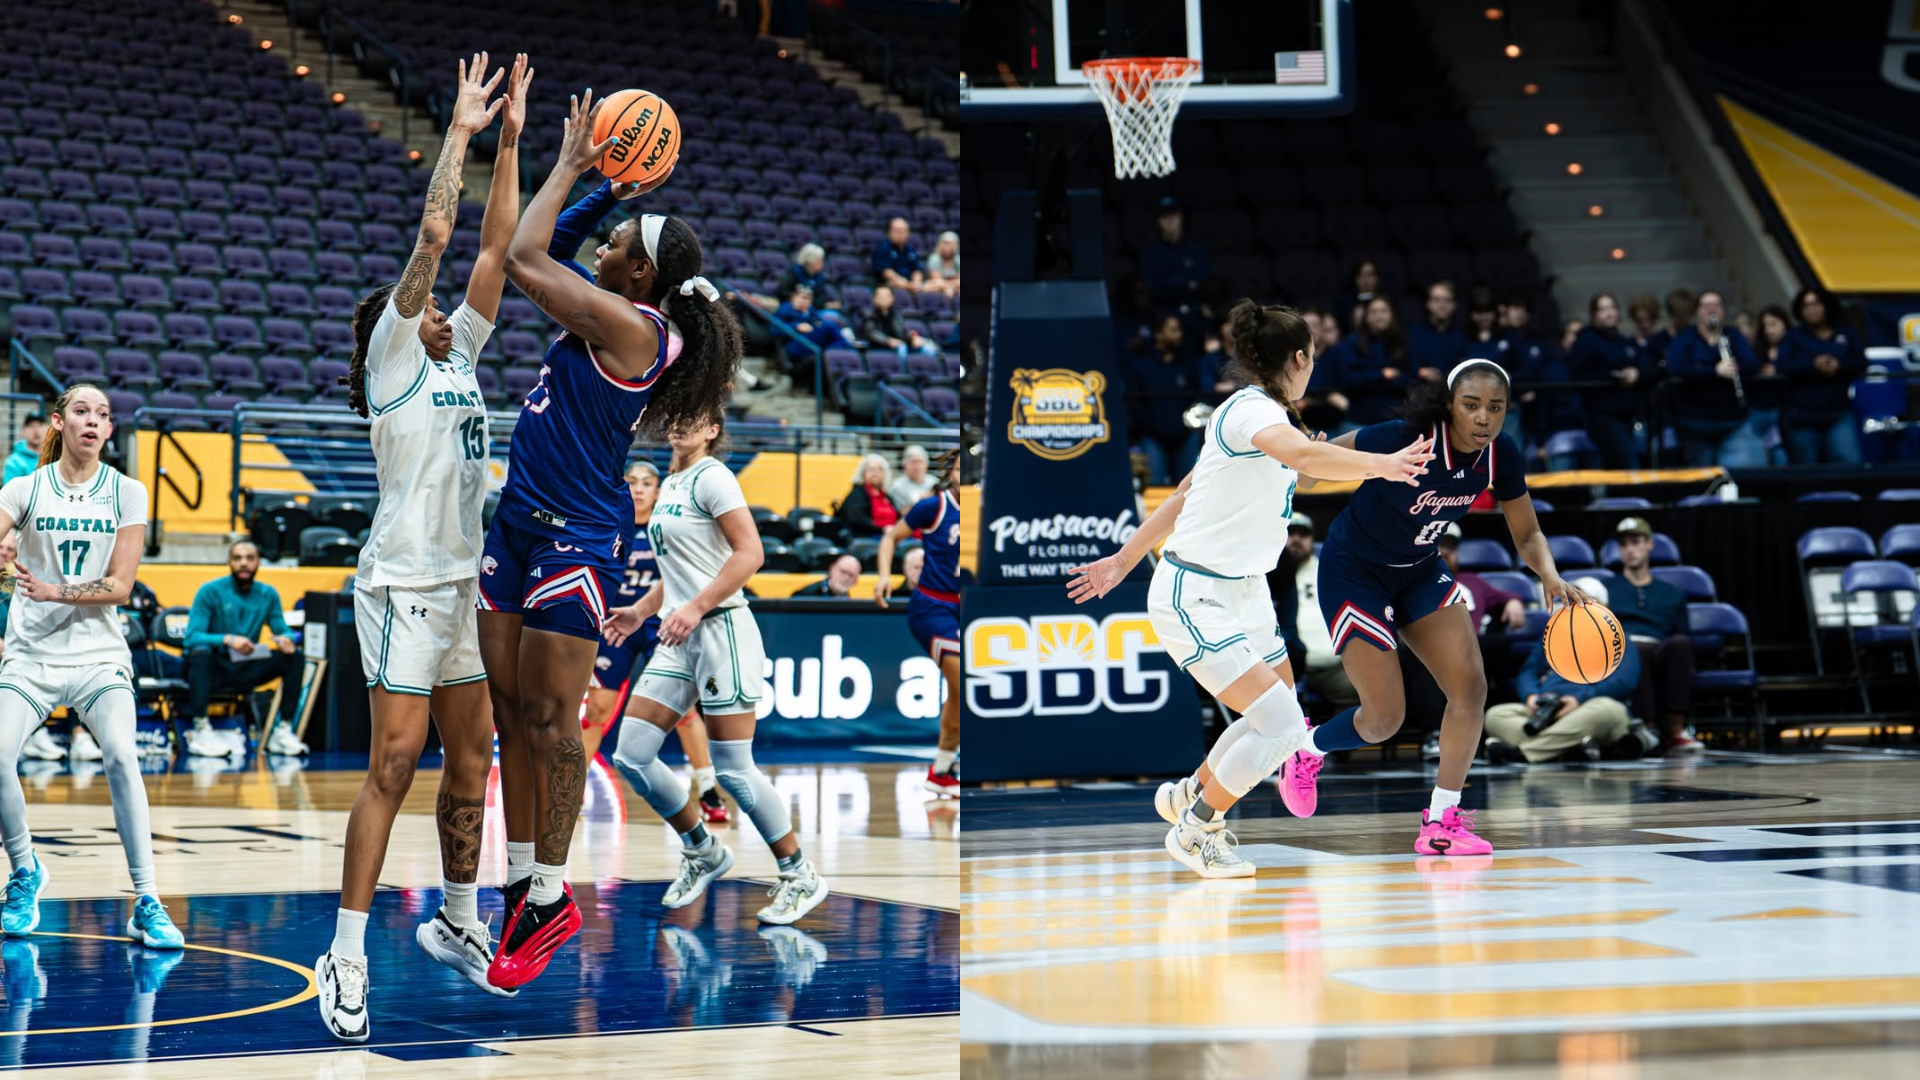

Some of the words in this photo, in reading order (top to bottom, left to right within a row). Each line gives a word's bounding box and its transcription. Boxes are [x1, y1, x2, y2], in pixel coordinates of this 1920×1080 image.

[609, 108, 654, 163] Wilson
[641, 127, 672, 171] NCAA
[459, 416, 485, 460] 15
[1012, 424, 1105, 439] CHAMPIONSHIPS
[1409, 490, 1477, 516] Jaguars
[36, 516, 115, 534] COASTAL
[988, 508, 1138, 553] Pensacola
[57, 539, 91, 576] 17
[1001, 563, 1028, 578] THE
[1028, 562, 1057, 577] WAY
[1028, 544, 1100, 558] FLORIDA
[1603, 614, 1622, 669] Wilson
[964, 612, 1169, 718] SBC
